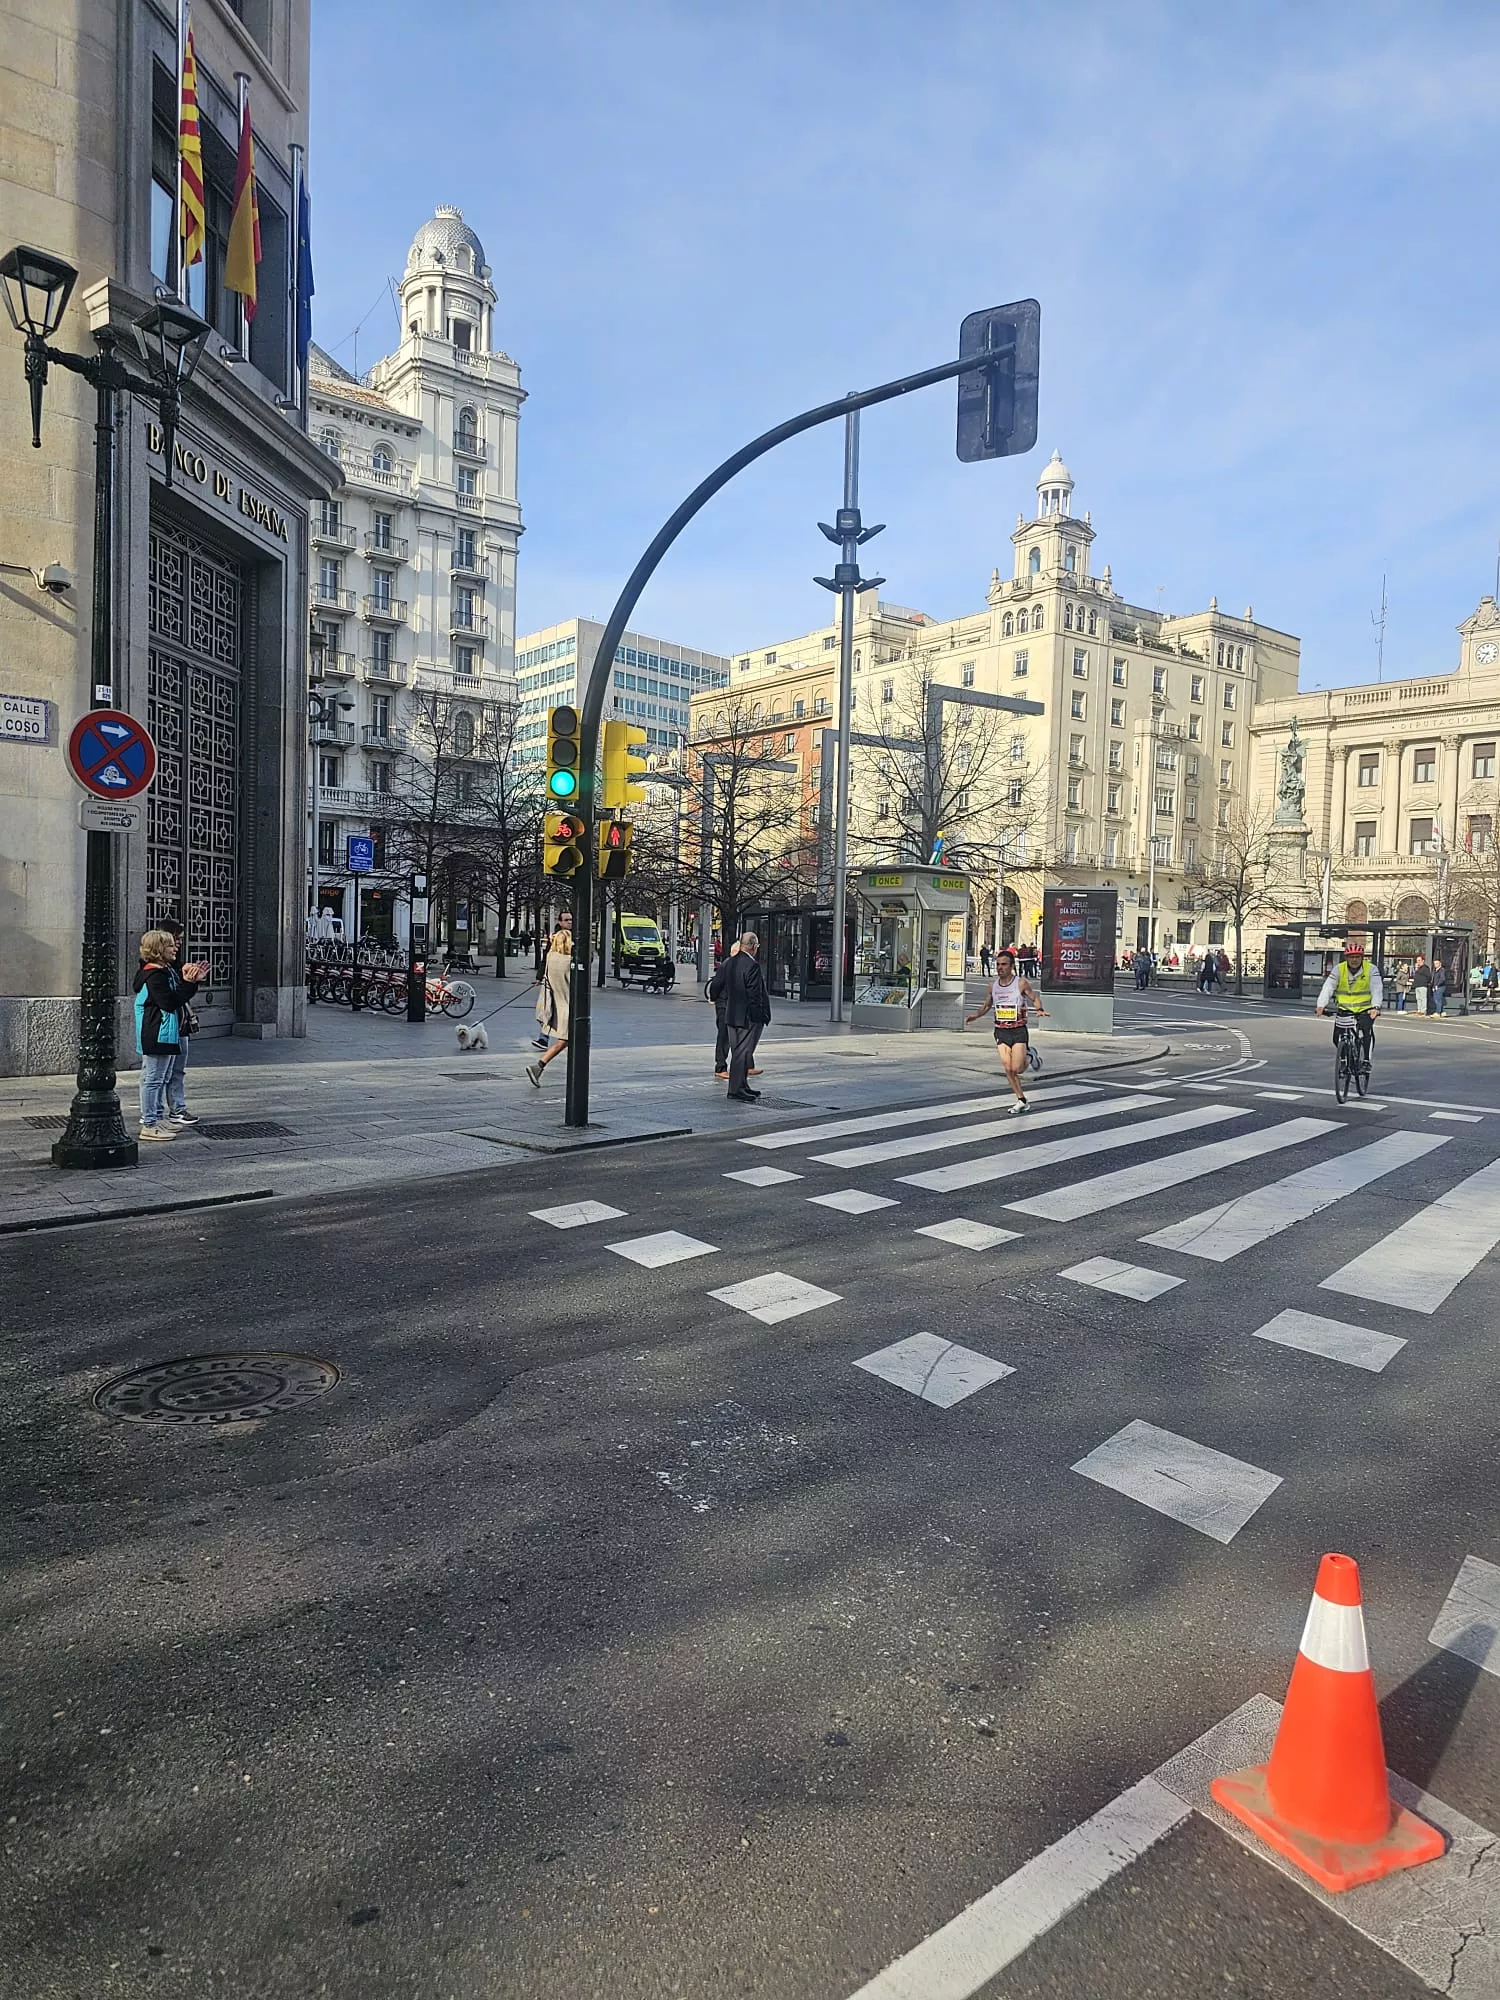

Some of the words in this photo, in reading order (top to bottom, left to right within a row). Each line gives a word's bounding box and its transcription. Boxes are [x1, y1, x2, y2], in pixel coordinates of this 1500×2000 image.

[215, 470, 233, 504] DE
[240, 489, 289, 543] ESPAÑA
[4, 702, 40, 715] CALLE
[5, 719, 40, 734] COSO
[879, 876, 900, 885] ONCE
[943, 879, 964, 889] ONCE
[319, 889, 340, 897] ange
